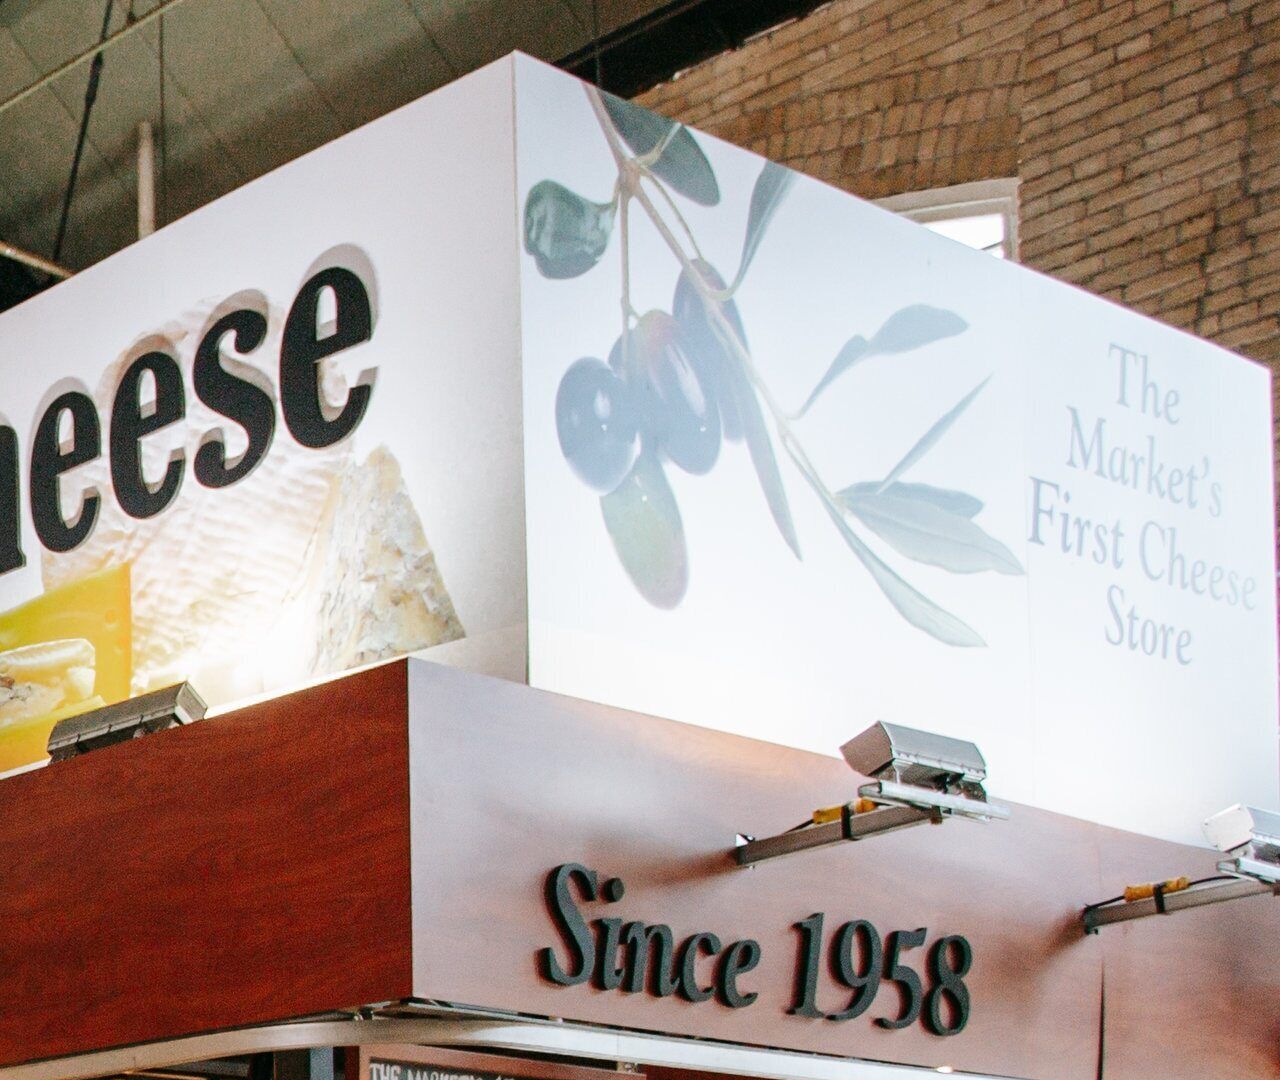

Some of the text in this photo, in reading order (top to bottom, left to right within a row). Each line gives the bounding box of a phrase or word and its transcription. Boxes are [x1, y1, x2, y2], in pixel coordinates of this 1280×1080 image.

[1108, 340, 1181, 426] The
[1065, 405, 1223, 519] Market's
[1027, 475, 1258, 612] First Cheese
[1105, 584, 1194, 666] Store
[538, 860, 975, 1038] Since 1958
